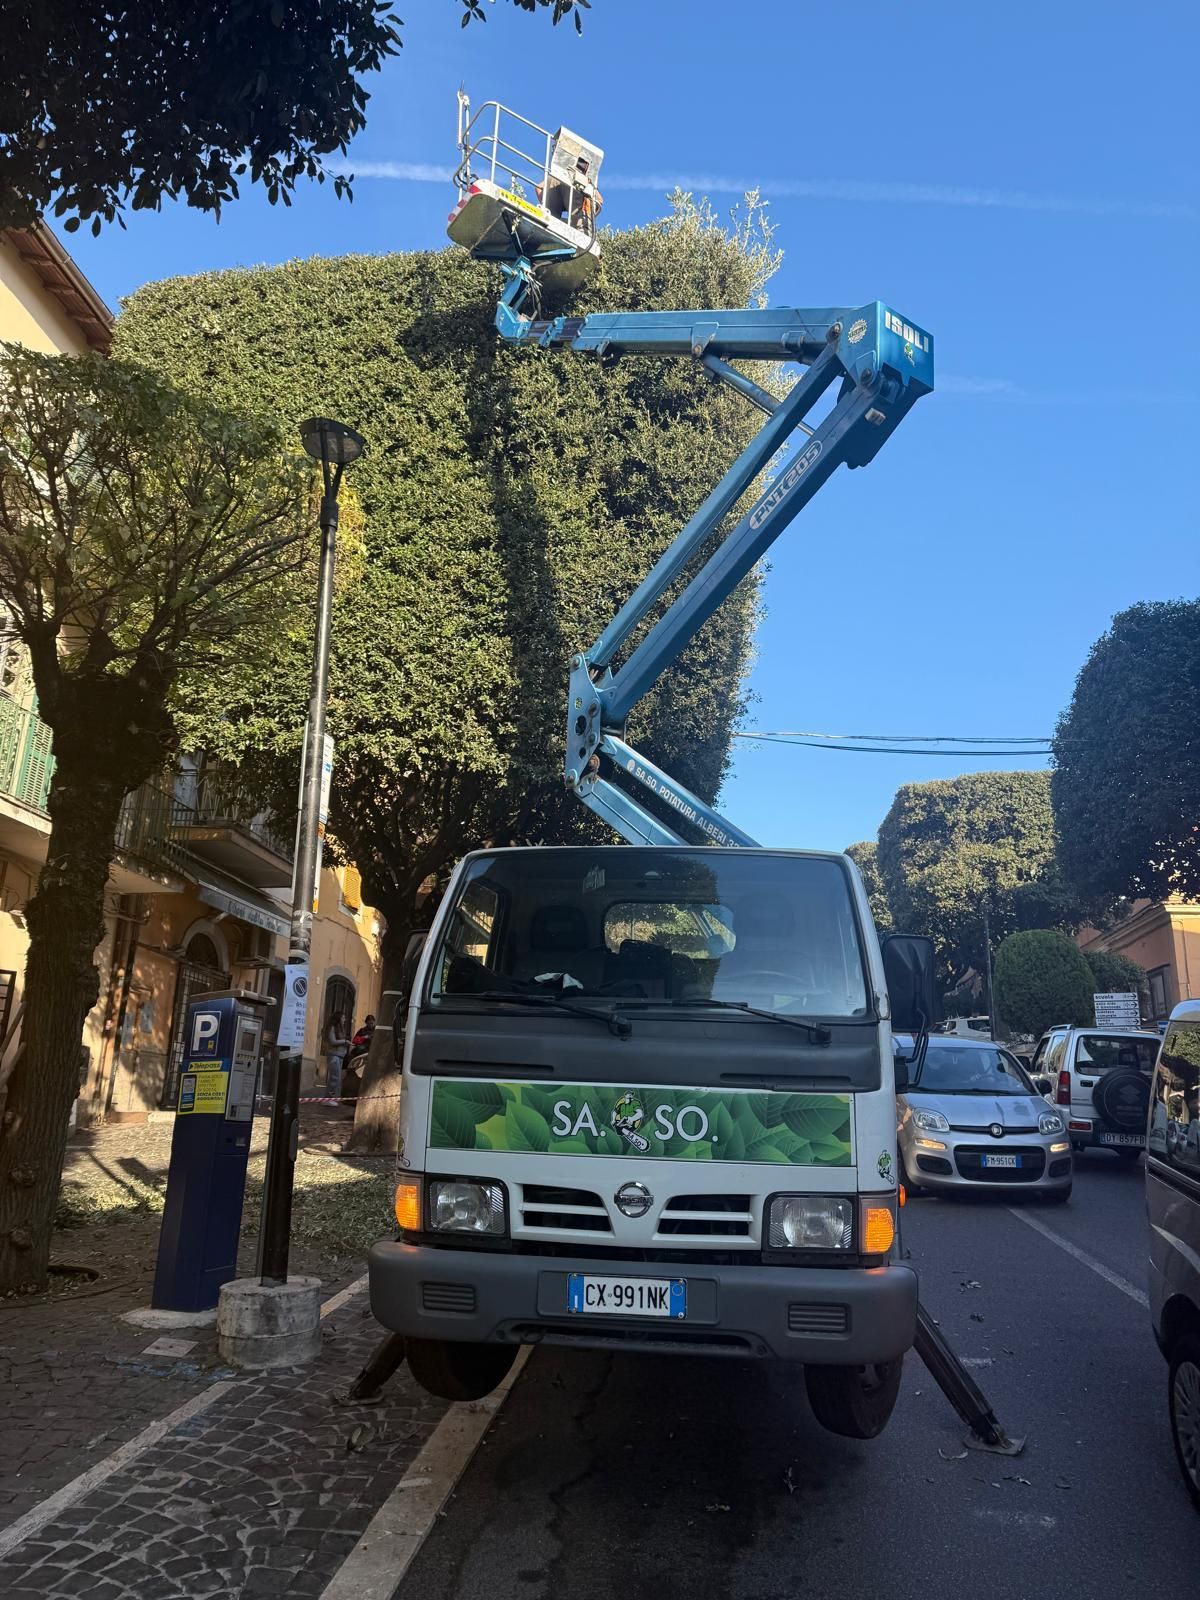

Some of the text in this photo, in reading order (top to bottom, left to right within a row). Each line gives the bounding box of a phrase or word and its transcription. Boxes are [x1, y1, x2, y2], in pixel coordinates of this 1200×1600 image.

[885, 310, 929, 353] ISOLI
[659, 785, 697, 822] POTATURA
[696, 816, 728, 845] ALBERI
[192, 1014, 219, 1051] P
[193, 1063, 221, 1071] Telepass
[552, 1101, 719, 1142] SA. SO.
[585, 1284, 606, 1307] CX
[613, 1285, 669, 1310] 991NK
